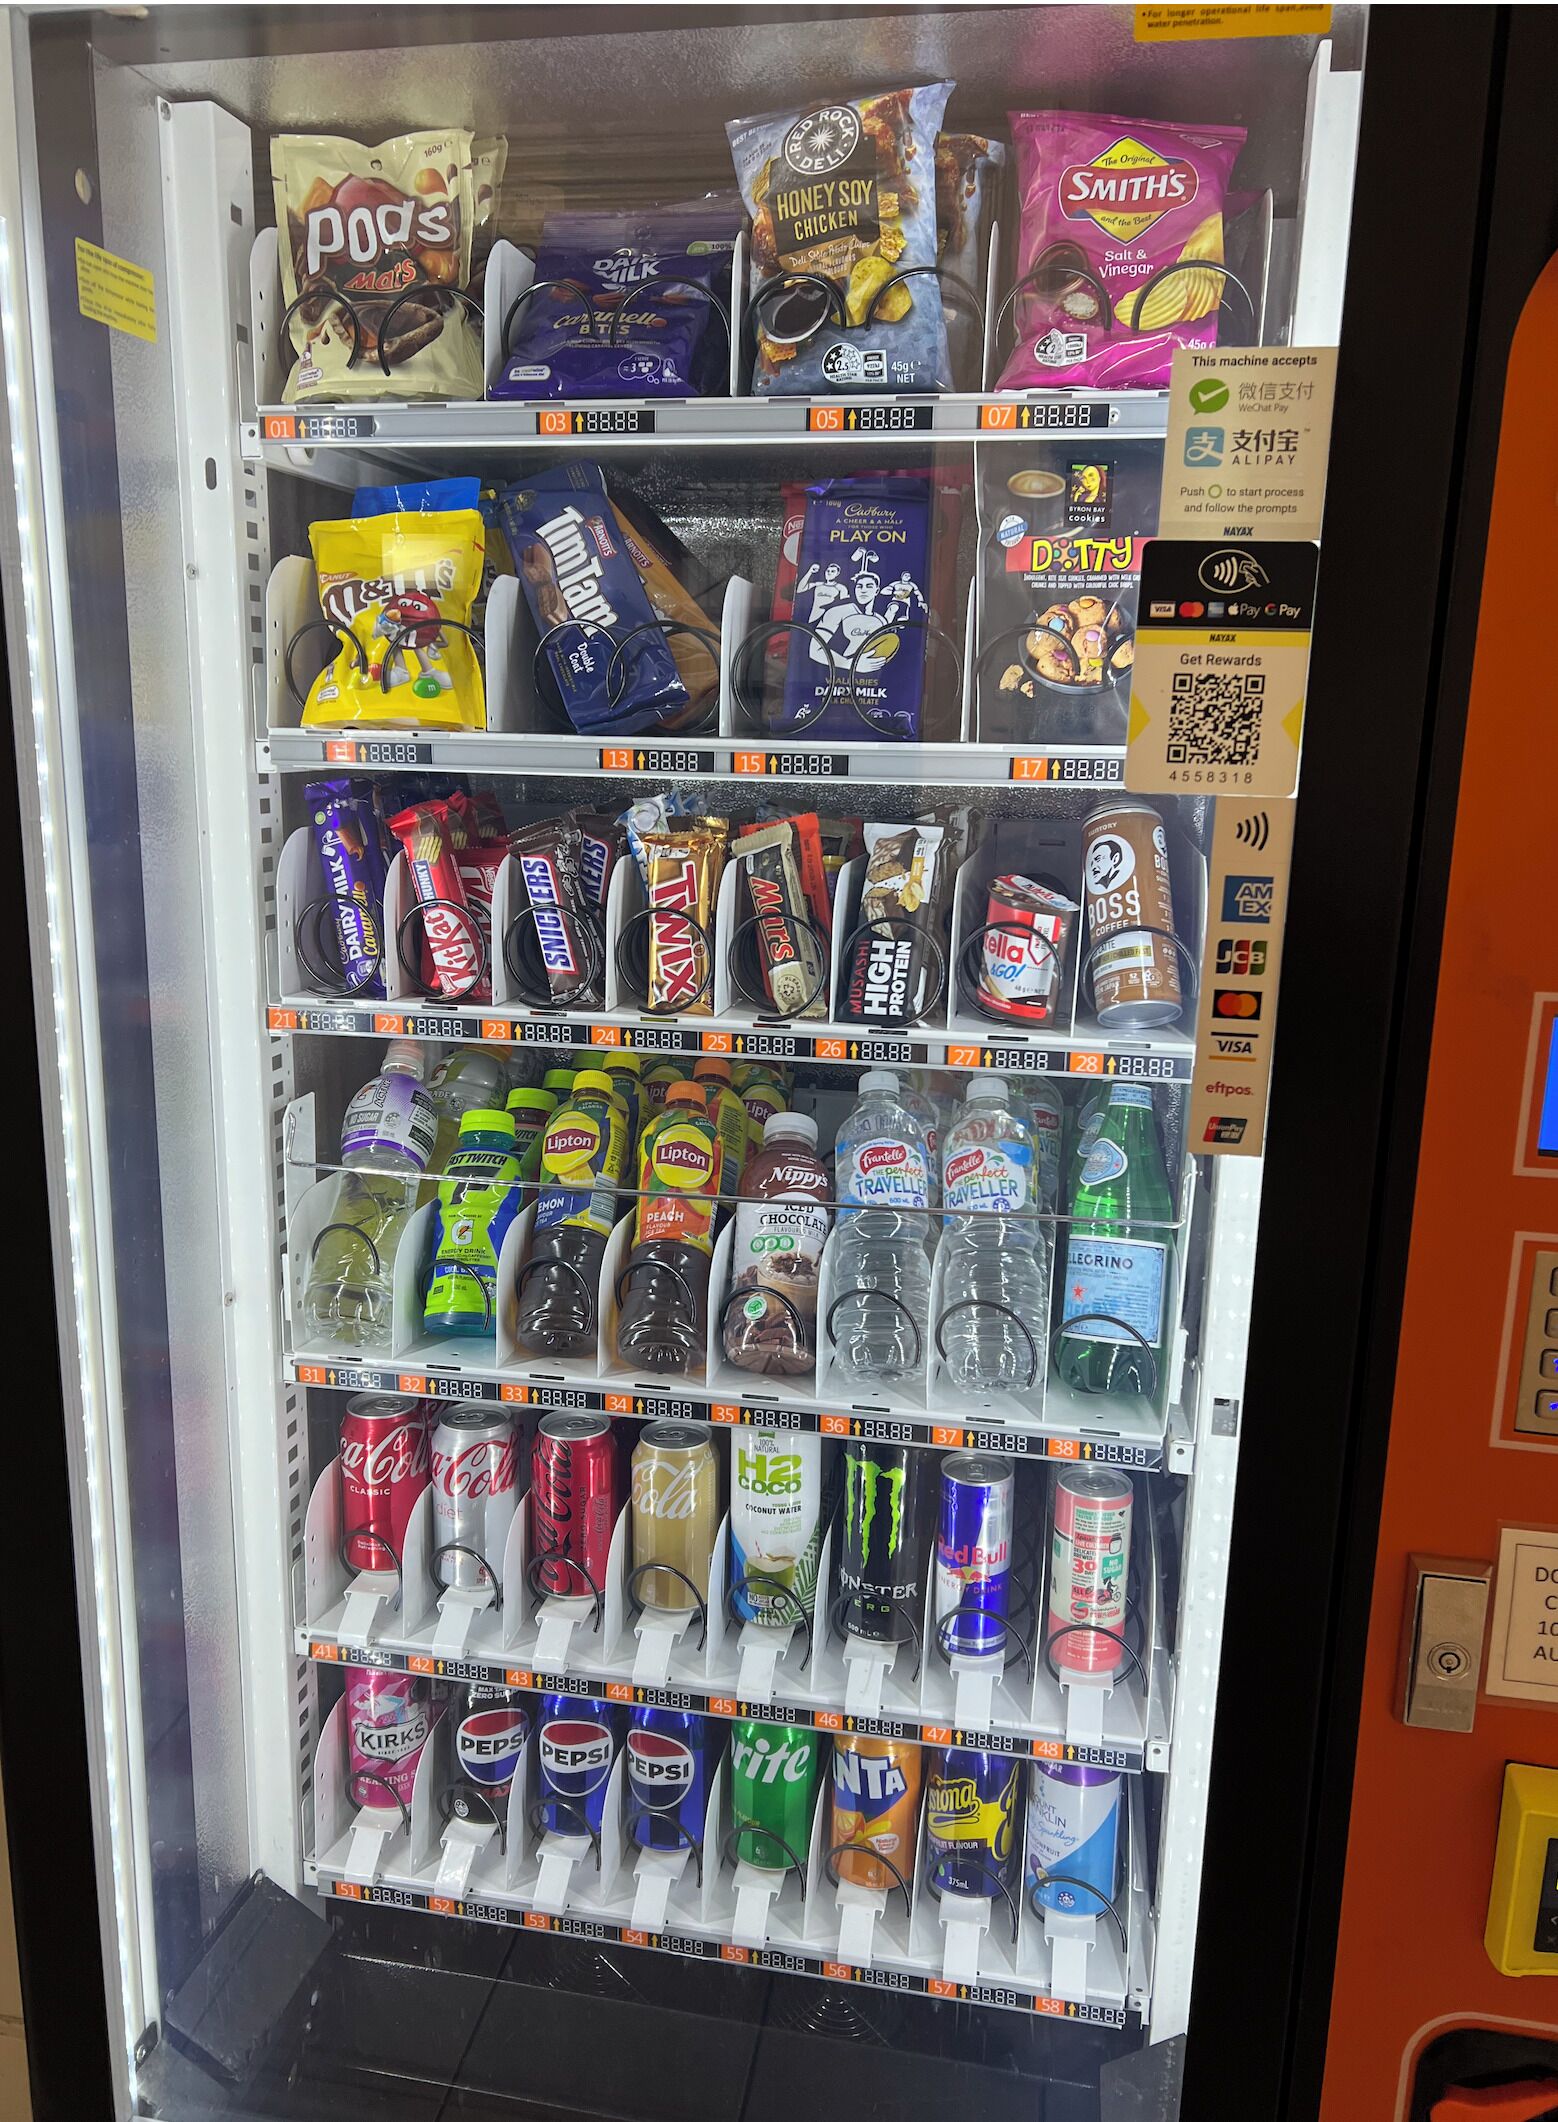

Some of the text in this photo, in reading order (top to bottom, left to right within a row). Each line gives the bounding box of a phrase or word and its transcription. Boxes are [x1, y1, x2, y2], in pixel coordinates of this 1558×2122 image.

[789, 119, 813, 154] RED
[819, 110, 855, 140] ROCK
[800, 147, 845, 170] DELI
[1102, 153, 1156, 167] The Original
[776, 179, 873, 221] HONEY SOY
[794, 210, 858, 241] CHICKEN
[1101, 214, 1152, 226] and the Best
[307, 200, 451, 276] pods
[1104, 249, 1147, 261] Salt &
[596, 262, 661, 284] MILK
[1099, 263, 1154, 279] Vinegar
[891, 361, 909, 373] 45g
[1192, 355, 1318, 368] This machine accepts
[896, 373, 915, 384] NET
[1238, 381, 1315, 401] 微信支付
[988, 407, 1011, 426] 07
[1239, 403, 1289, 415] WeChat Pay
[546, 413, 566, 431] 03
[816, 410, 838, 429] 05
[270, 421, 290, 438] 01
[1230, 429, 1299, 453] 支付宝
[1232, 454, 1296, 465] ALIPAY
[1180, 487, 1304, 498] Push to start process
[844, 502, 897, 518] Cadbury
[1184, 503, 1297, 515] and follow the prompts
[1068, 513, 1106, 523] cookies
[829, 530, 906, 543] PLAY ON
[1223, 526, 1254, 536] NAYAX
[1240, 604, 1261, 618] Pay
[1279, 604, 1301, 619] Pay
[1209, 633, 1236, 643] NAYAX
[568, 652, 584, 674] Coat
[577, 641, 594, 673] Double
[1180, 653, 1262, 666] Get Rewards
[856, 687, 888, 698] MILK
[609, 751, 628, 768] 13
[741, 755, 761, 772] 15
[1020, 760, 1043, 778] 17
[1168, 771, 1253, 784] 4558318
[1238, 883, 1273, 899] AM
[527, 859, 571, 970] SNICKERS
[1088, 890, 1141, 929] BOSS
[1241, 900, 1271, 914] EX
[750, 877, 795, 962] Mars
[340, 904, 363, 961] DAIRY
[653, 861, 697, 1003] TWIX
[1095, 920, 1129, 937] COFFEE
[1216, 951, 1265, 965] JCB
[849, 940, 871, 1015] MUSASHI
[864, 940, 896, 1016] HIGH
[888, 940, 912, 1016] PROTEIN
[274, 1012, 297, 1028] 21
[380, 1017, 398, 1033] 22
[487, 1022, 506, 1039] 23
[597, 1029, 616, 1045] 24
[708, 1034, 727, 1051] 25
[821, 1041, 841, 1058] 26
[1217, 1040, 1252, 1054] VISA
[953, 1048, 974, 1065] 27
[1076, 1055, 1098, 1072] 28
[547, 1134, 592, 1151] Lipton
[660, 1147, 706, 1168] Lipton
[861, 1147, 907, 1170] frantelle
[768, 1166, 828, 1190] Nippy's
[884, 1164, 924, 1180] perfect
[647, 1210, 685, 1224] PEACH
[760, 1213, 827, 1235] CHOCOLATE
[303, 1367, 321, 1383] 31
[403, 1376, 420, 1392] 32
[505, 1386, 523, 1402] 33
[609, 1396, 628, 1412] 34
[716, 1406, 735, 1422] 35
[825, 1417, 844, 1433] 36
[937, 1429, 957, 1444] 37
[1053, 1440, 1074, 1456] 38
[737, 1447, 803, 1482] H2
[350, 1485, 391, 1496] CLASSIC
[437, 1503, 463, 1520] diet
[745, 1503, 802, 1515] COCONUT WATER
[971, 1541, 1008, 1565] Bull
[316, 1645, 332, 1658] 41
[412, 1656, 430, 1671] 42
[510, 1671, 528, 1685] 43
[610, 1685, 629, 1699] 44
[713, 1699, 732, 1713] 45
[819, 1713, 838, 1727] 46
[360, 1724, 426, 1748] KIRKS
[928, 1727, 947, 1742] 47
[542, 1745, 609, 1767] PEPSI
[1038, 1742, 1058, 1756] 48
[628, 1752, 689, 1781] PEPSI
[949, 1841, 979, 1850] FLAVOUR
[340, 1884, 356, 1897] 51
[948, 1876, 969, 1890] 375mL
[434, 1899, 450, 1912] 52
[529, 1914, 545, 1928] 53
[626, 1931, 643, 1944] 54
[726, 1946, 743, 1960] 55
[828, 1964, 846, 1978] 56
[933, 1980, 952, 1994] 57
[1041, 1999, 1060, 2013] 58
